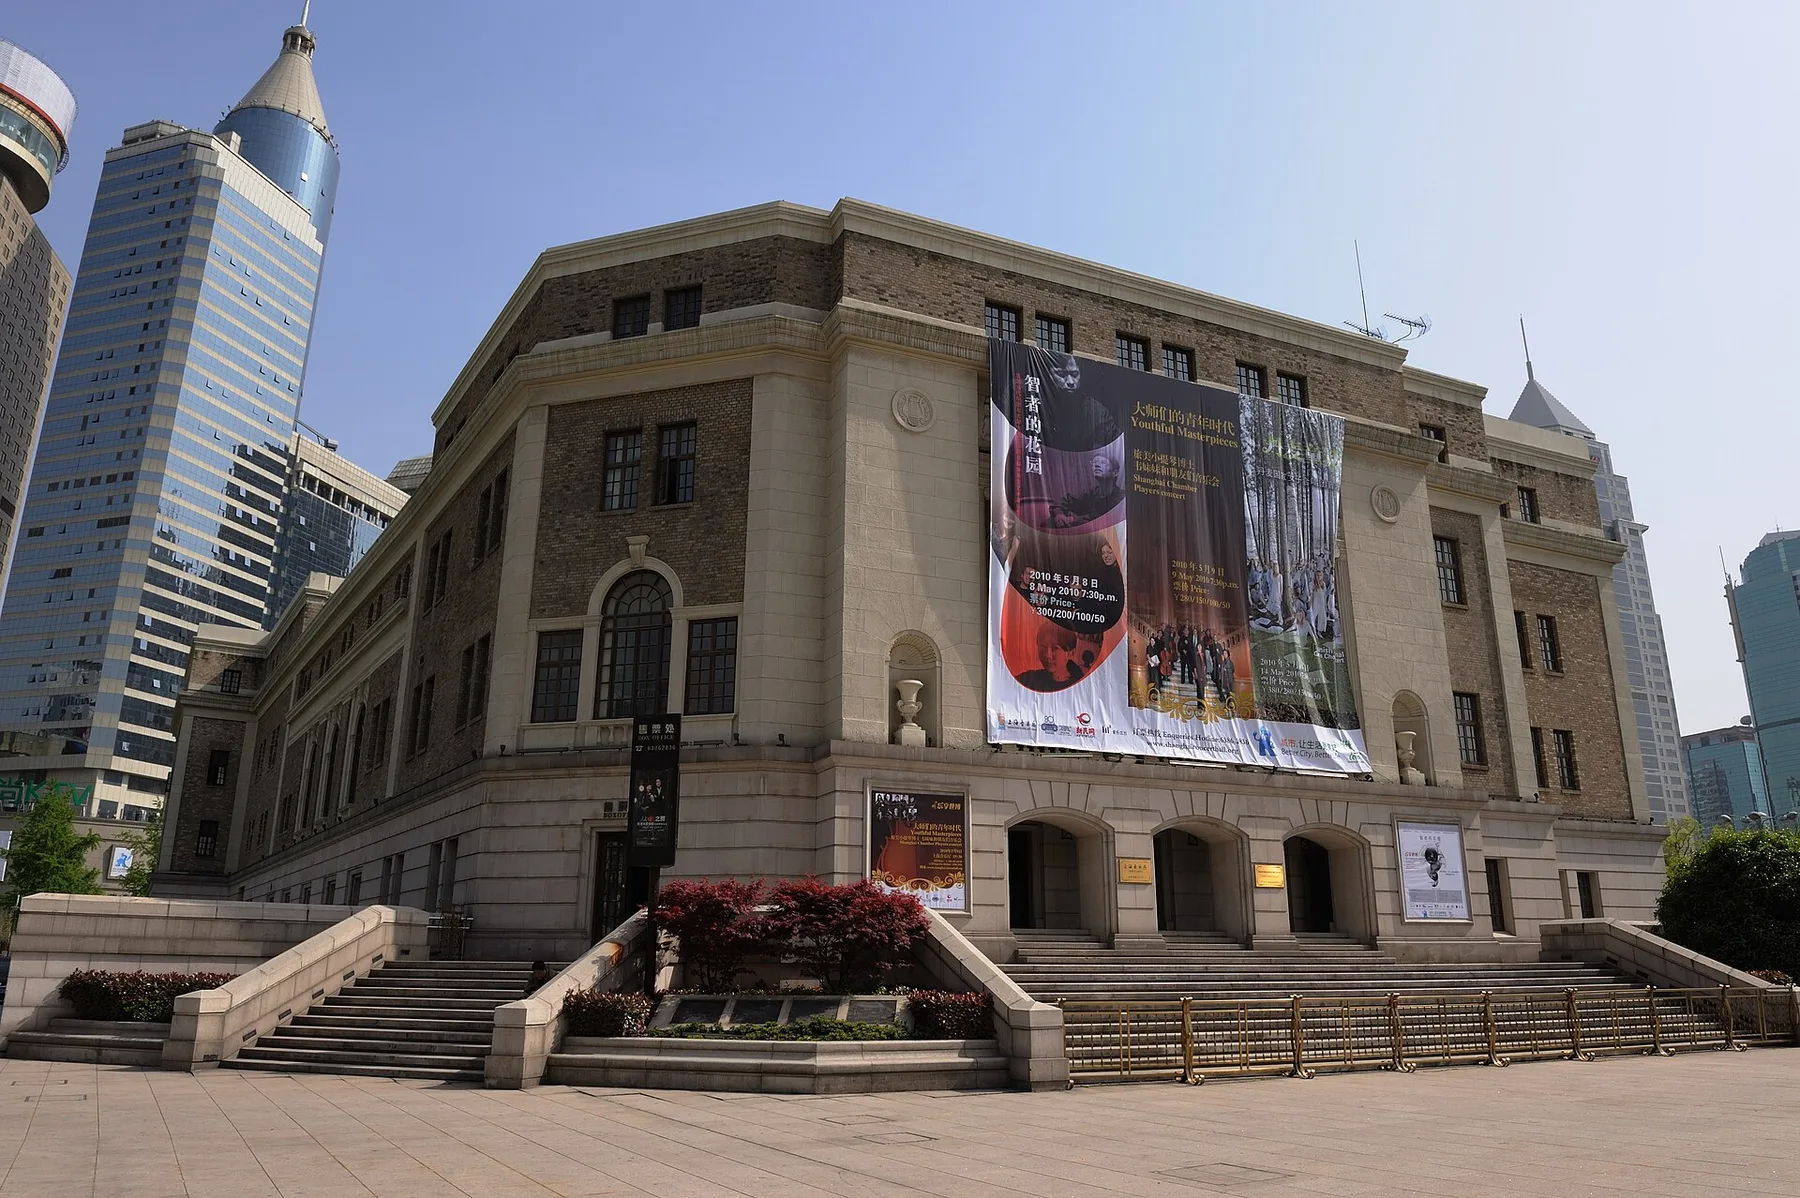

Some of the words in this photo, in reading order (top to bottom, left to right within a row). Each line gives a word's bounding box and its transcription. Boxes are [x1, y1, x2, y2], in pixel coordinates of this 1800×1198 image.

[1025, 374, 1042, 475] 智者的花园
[1132, 400, 1235, 436] 大师们的青年时代
[1131, 416, 1174, 435] Youthful
[1177, 426, 1238, 448] Masterpieces
[1134, 474, 1165, 487] Shanghai
[1167, 480, 1198, 492] Chamber
[1134, 484, 1160, 495] Players
[1161, 490, 1185, 500] concert
[1179, 572, 1194, 582] May
[1196, 575, 1209, 583] 2010
[1038, 583, 1056, 595] May
[1059, 586, 1079, 597] 2010
[1081, 589, 1118, 601] 7:30p.m.
[1030, 593, 1048, 605] 票价
[1050, 597, 1075, 608] Price:
[1270, 669, 1285, 678] May
[639, 724, 674, 734] 售票处
[1076, 726, 1095, 735] 新民网
[1281, 748, 1298, 757] Better
